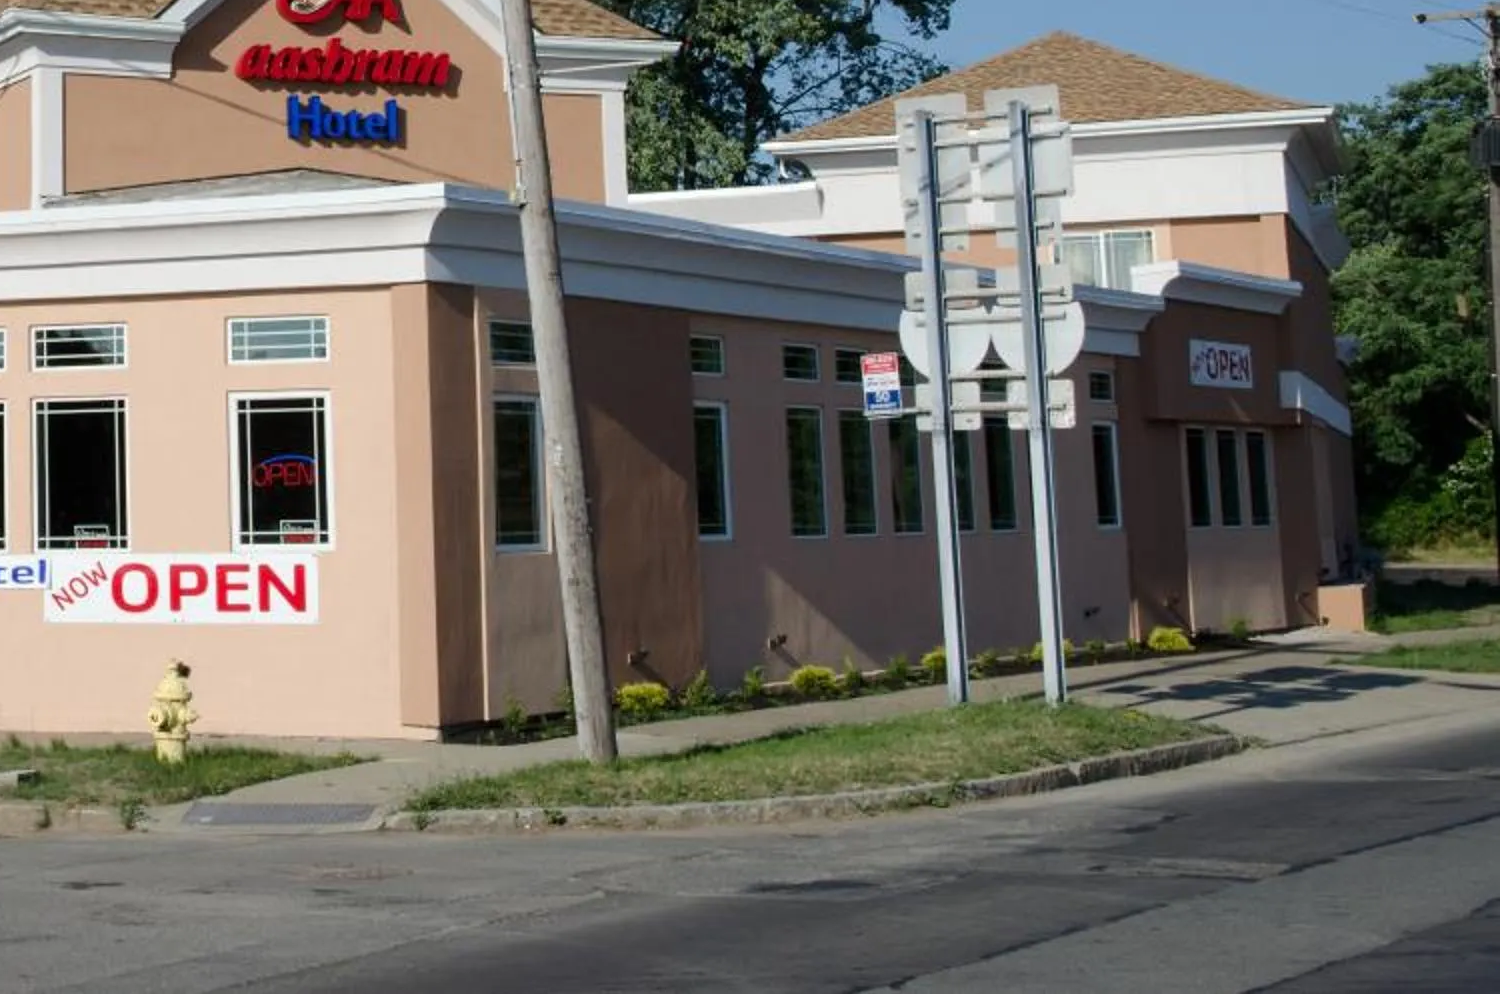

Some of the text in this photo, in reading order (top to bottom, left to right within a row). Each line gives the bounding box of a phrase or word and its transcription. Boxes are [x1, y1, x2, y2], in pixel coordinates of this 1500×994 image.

[287, 94, 397, 142] Hotel
[1206, 348, 1250, 382] OPEN
[253, 463, 318, 487] OPEN
[51, 560, 307, 613] NOW OPEN
